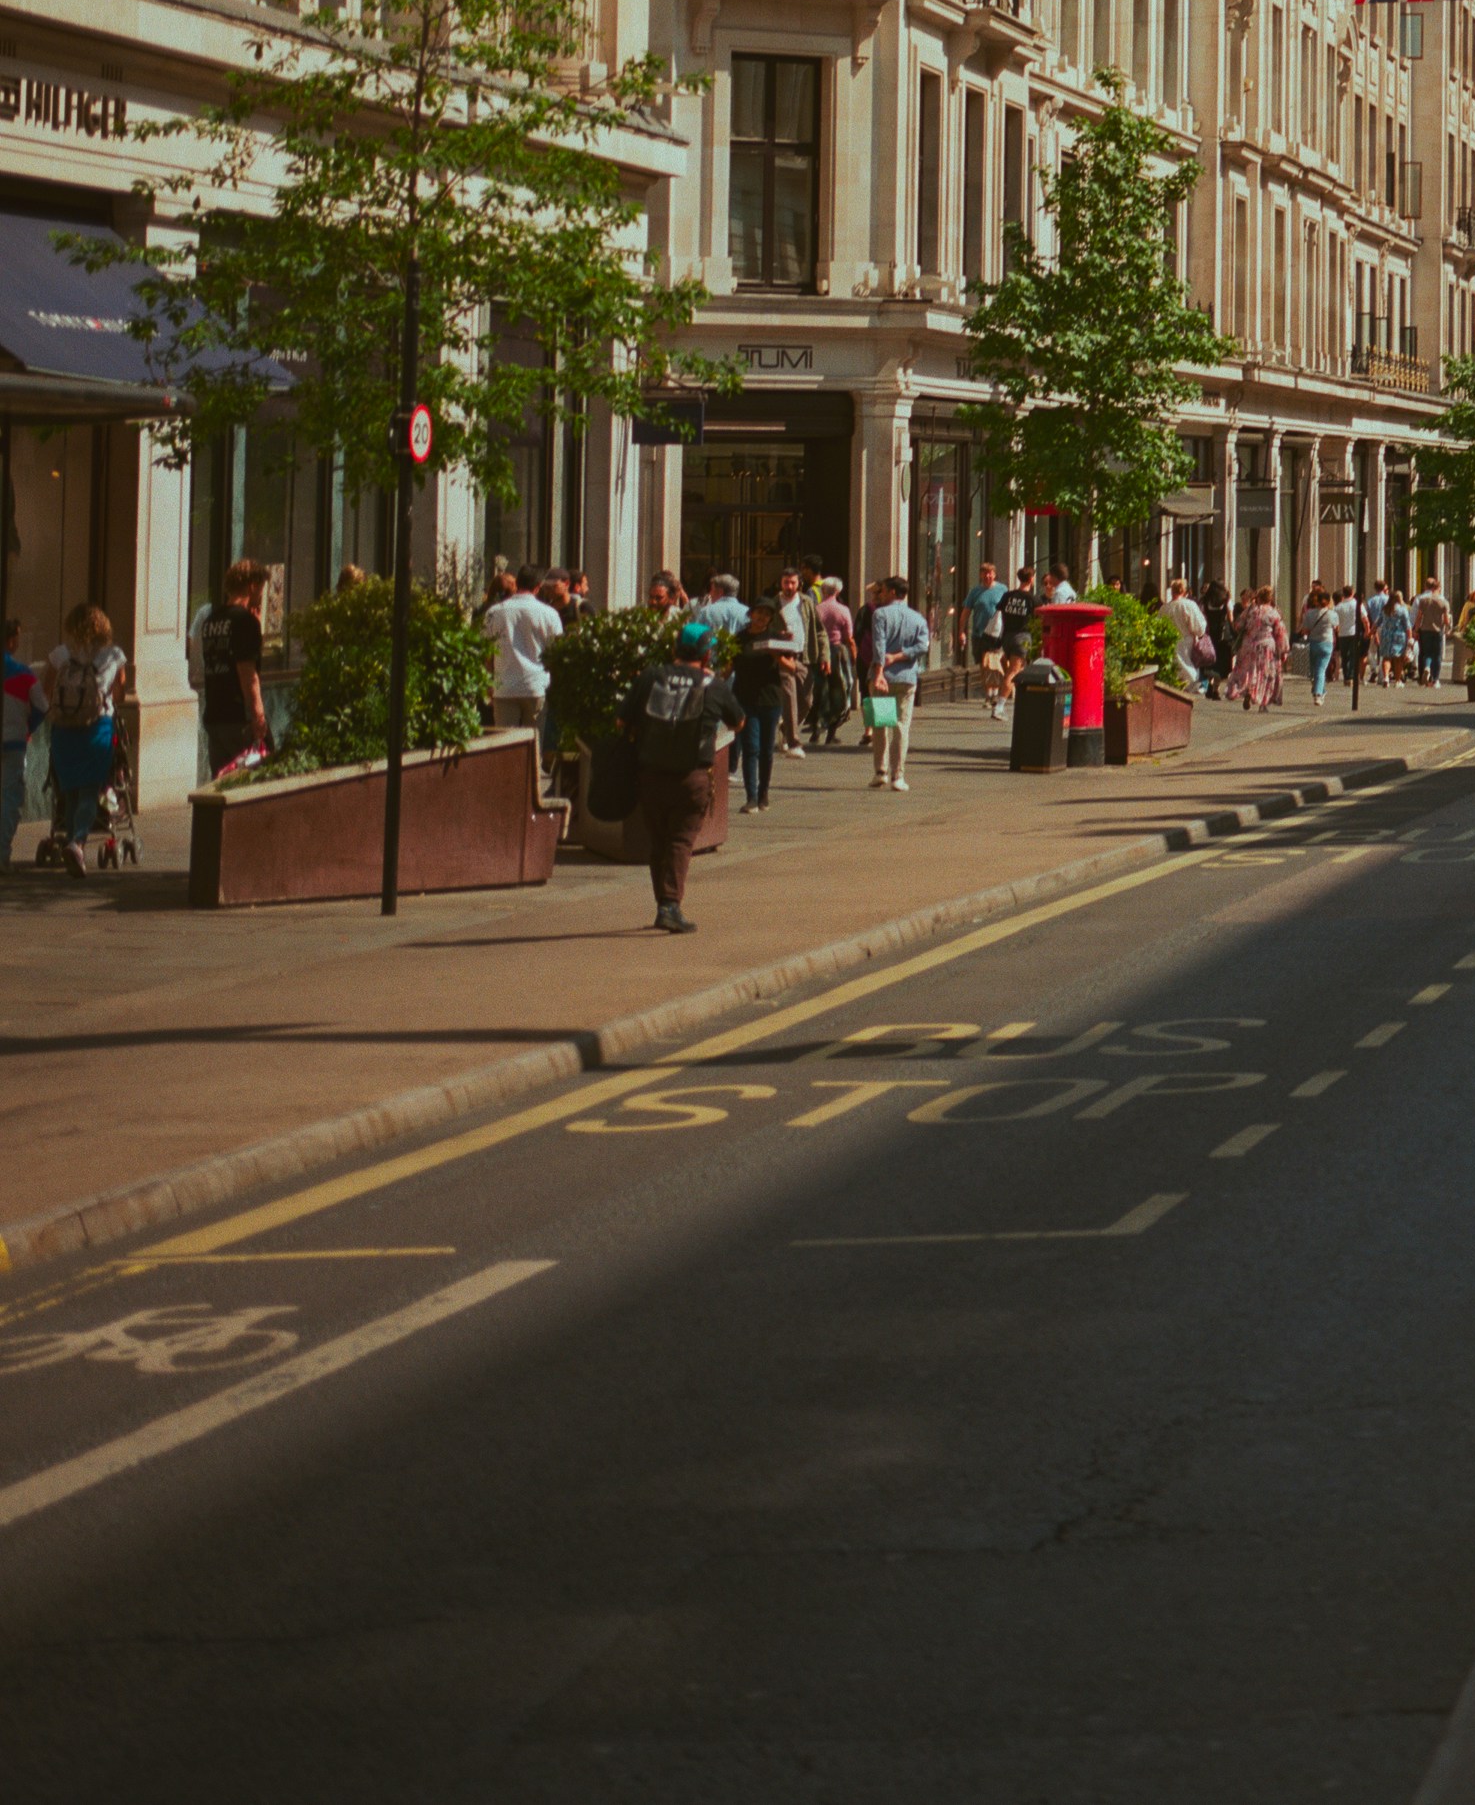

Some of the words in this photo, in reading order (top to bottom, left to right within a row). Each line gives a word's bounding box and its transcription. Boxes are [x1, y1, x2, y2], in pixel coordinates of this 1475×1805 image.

[26, 76, 127, 140] HILFIGER
[738, 344, 813, 370] TUMI
[415, 421, 430, 445] 20
[795, 1017, 1268, 1062] BUS
[566, 1071, 1268, 1133] STOP
